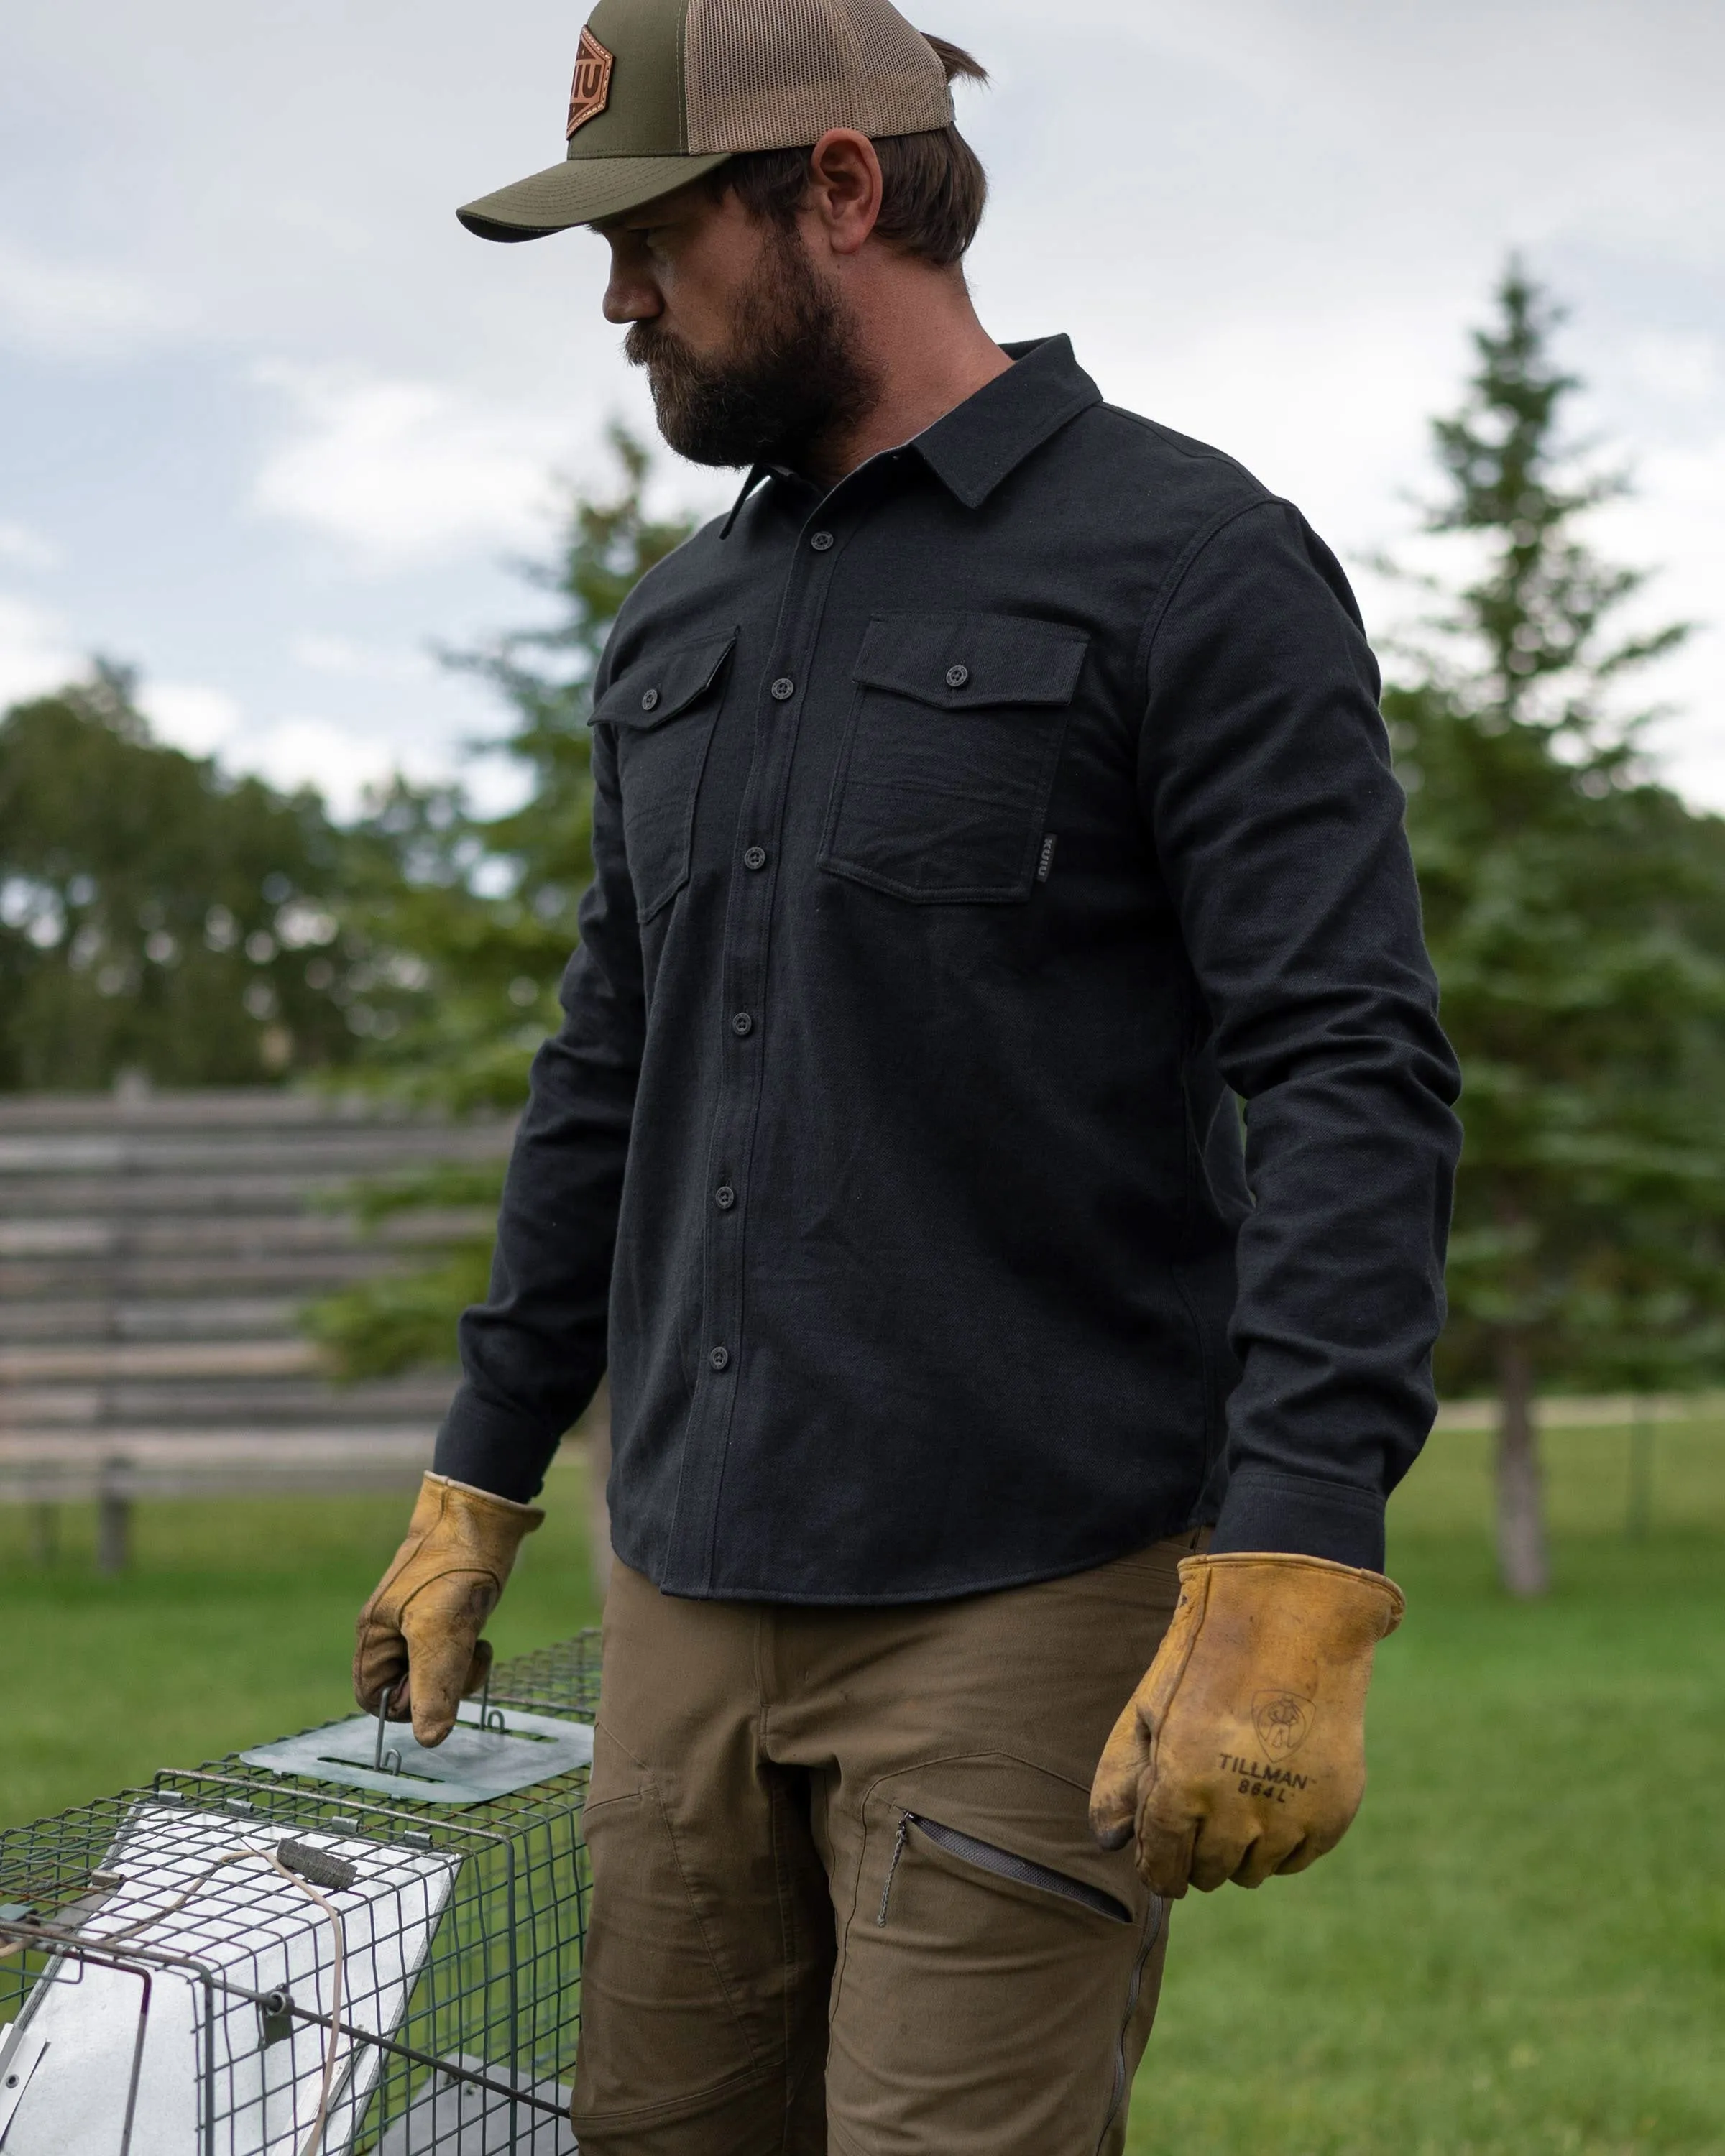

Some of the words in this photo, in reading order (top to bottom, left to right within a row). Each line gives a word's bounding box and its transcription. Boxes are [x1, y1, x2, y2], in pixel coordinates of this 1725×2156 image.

[571, 64, 602, 98] IU
[1038, 839, 1052, 877] KUIU
[1219, 1752, 1308, 1790] TILLMAN
